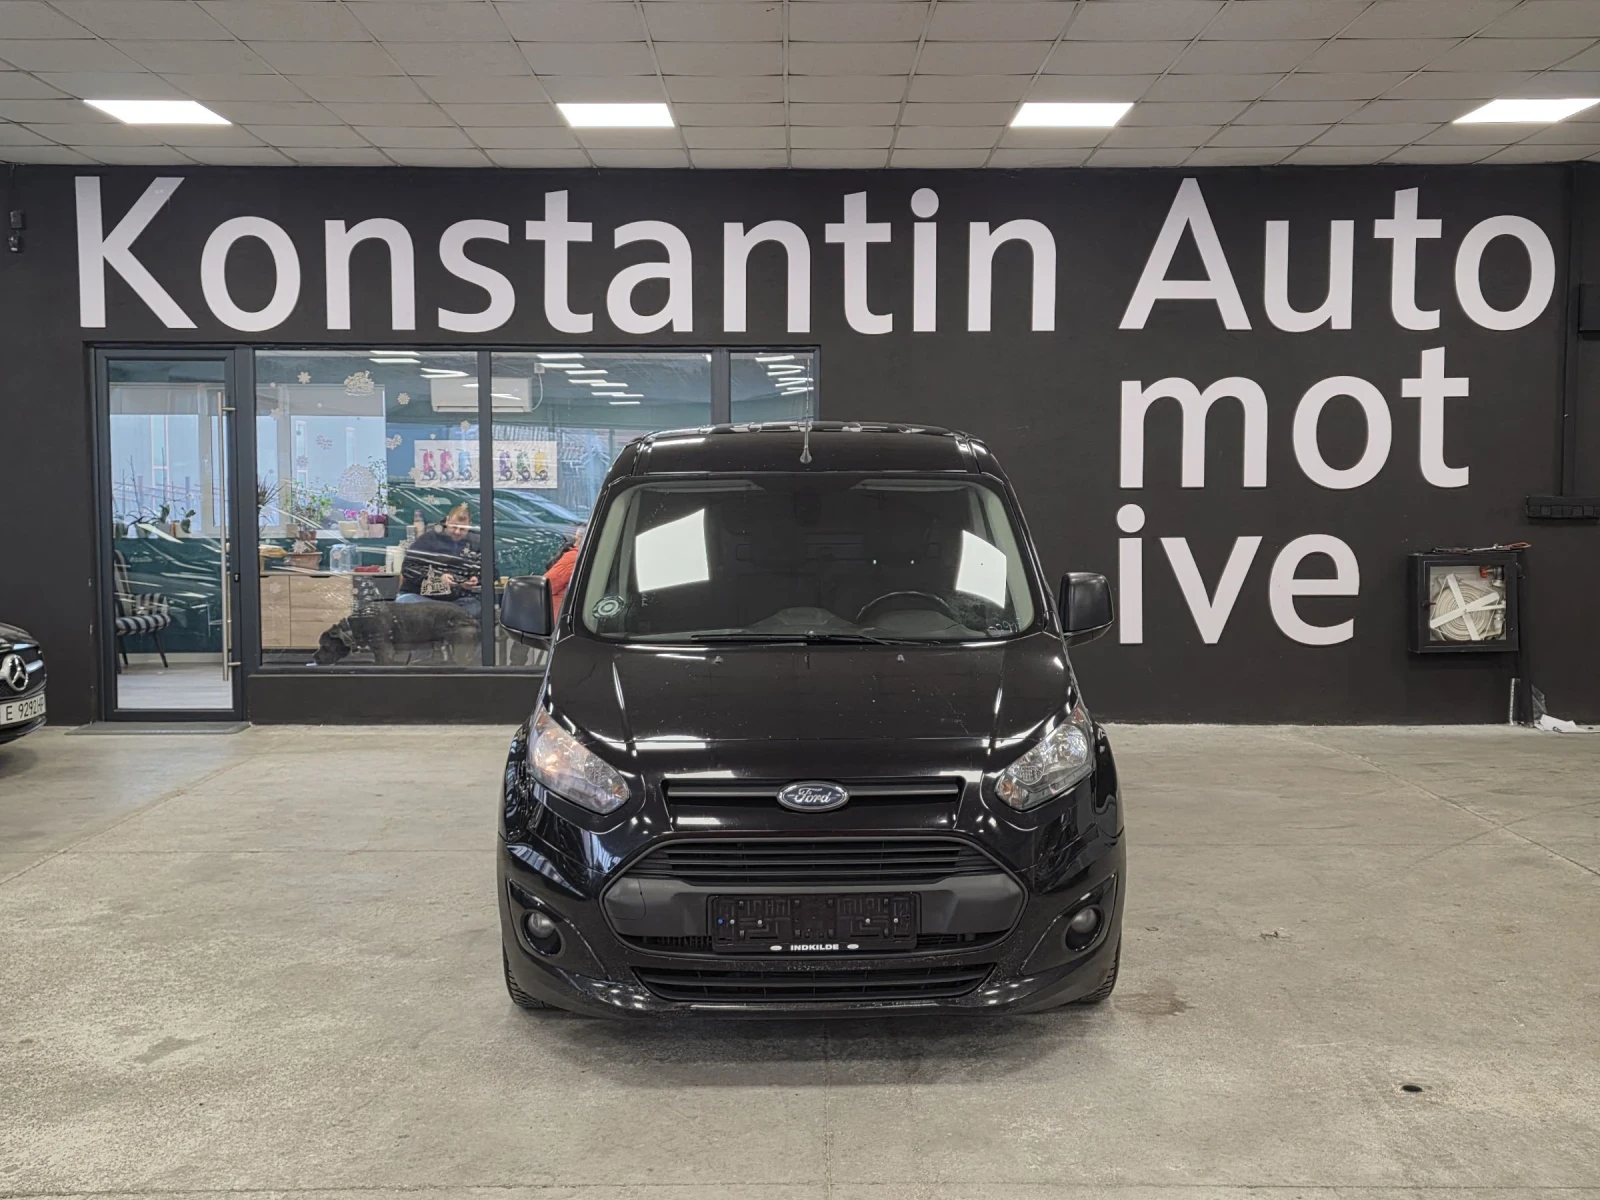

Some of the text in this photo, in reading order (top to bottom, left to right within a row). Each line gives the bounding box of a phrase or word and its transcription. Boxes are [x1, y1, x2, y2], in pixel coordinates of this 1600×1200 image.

[75, 176, 1556, 335] Konstantin Auto
[1119, 346, 1470, 490] mot
[1116, 503, 1361, 646] ive
[794, 787, 832, 803] Ford
[790, 943, 839, 951] INDKILDE
